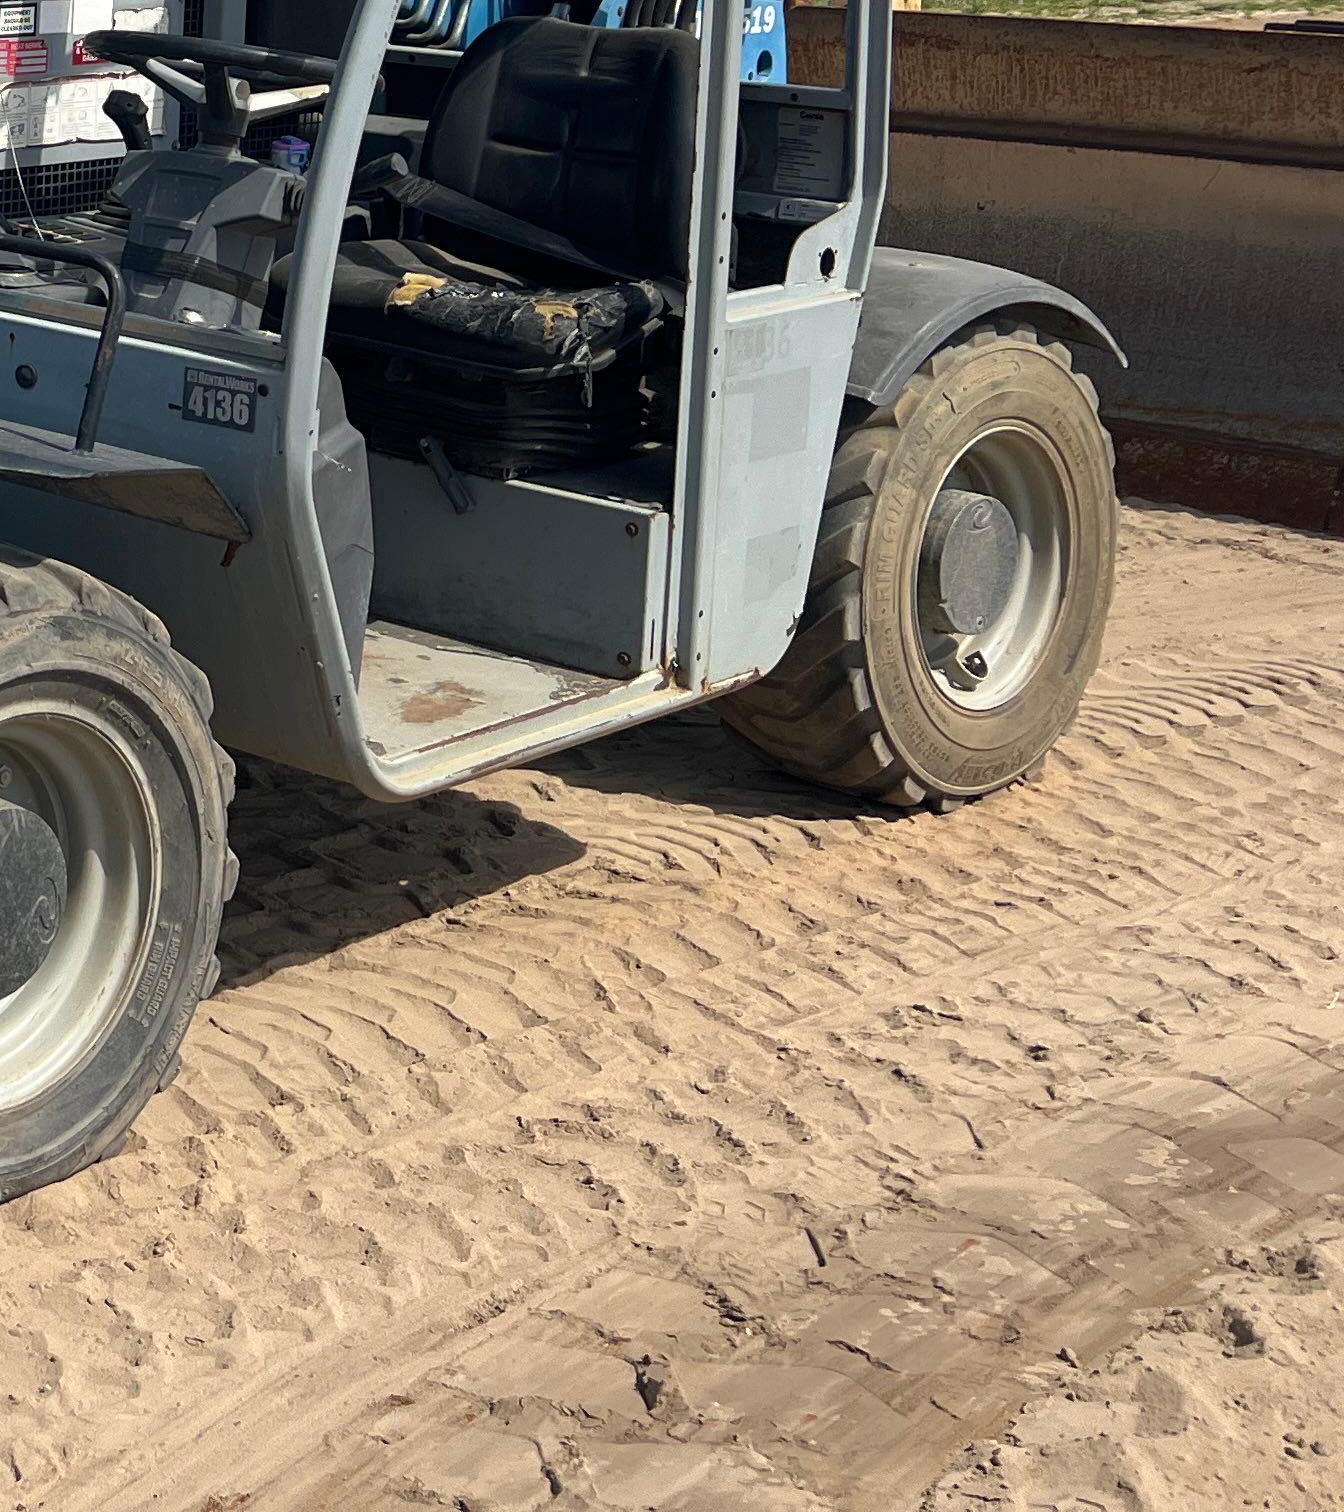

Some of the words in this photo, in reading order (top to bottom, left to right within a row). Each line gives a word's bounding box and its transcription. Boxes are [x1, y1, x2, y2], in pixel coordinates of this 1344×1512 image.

[188, 385, 250, 426] 4136
[161, 936, 181, 980] IMPACT
[146, 978, 169, 1017] GUARD
